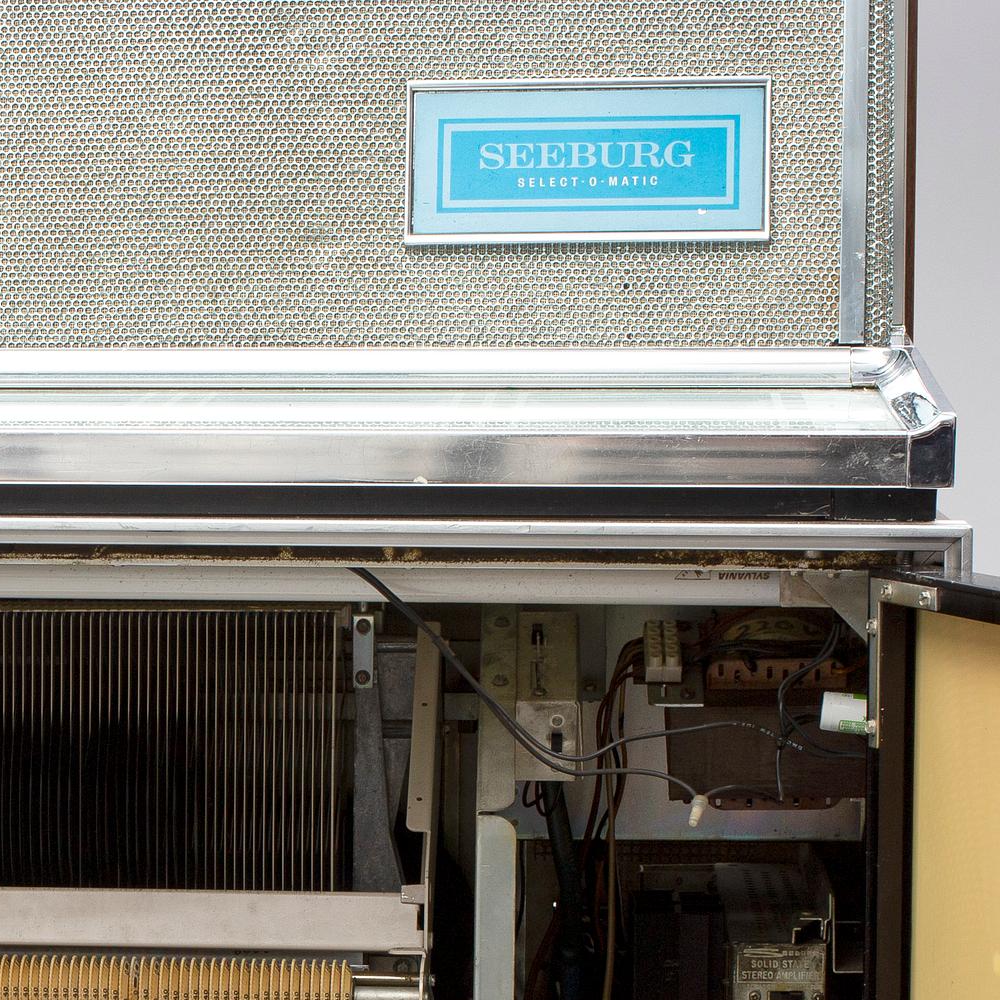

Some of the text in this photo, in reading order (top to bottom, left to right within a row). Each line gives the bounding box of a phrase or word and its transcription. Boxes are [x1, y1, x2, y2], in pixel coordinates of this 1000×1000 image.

[478, 140, 695, 170] SEEBURG
[718, 572, 770, 580] SYLVANIA
[751, 960, 779, 969] SOLID
[742, 971, 773, 980] STEREO
